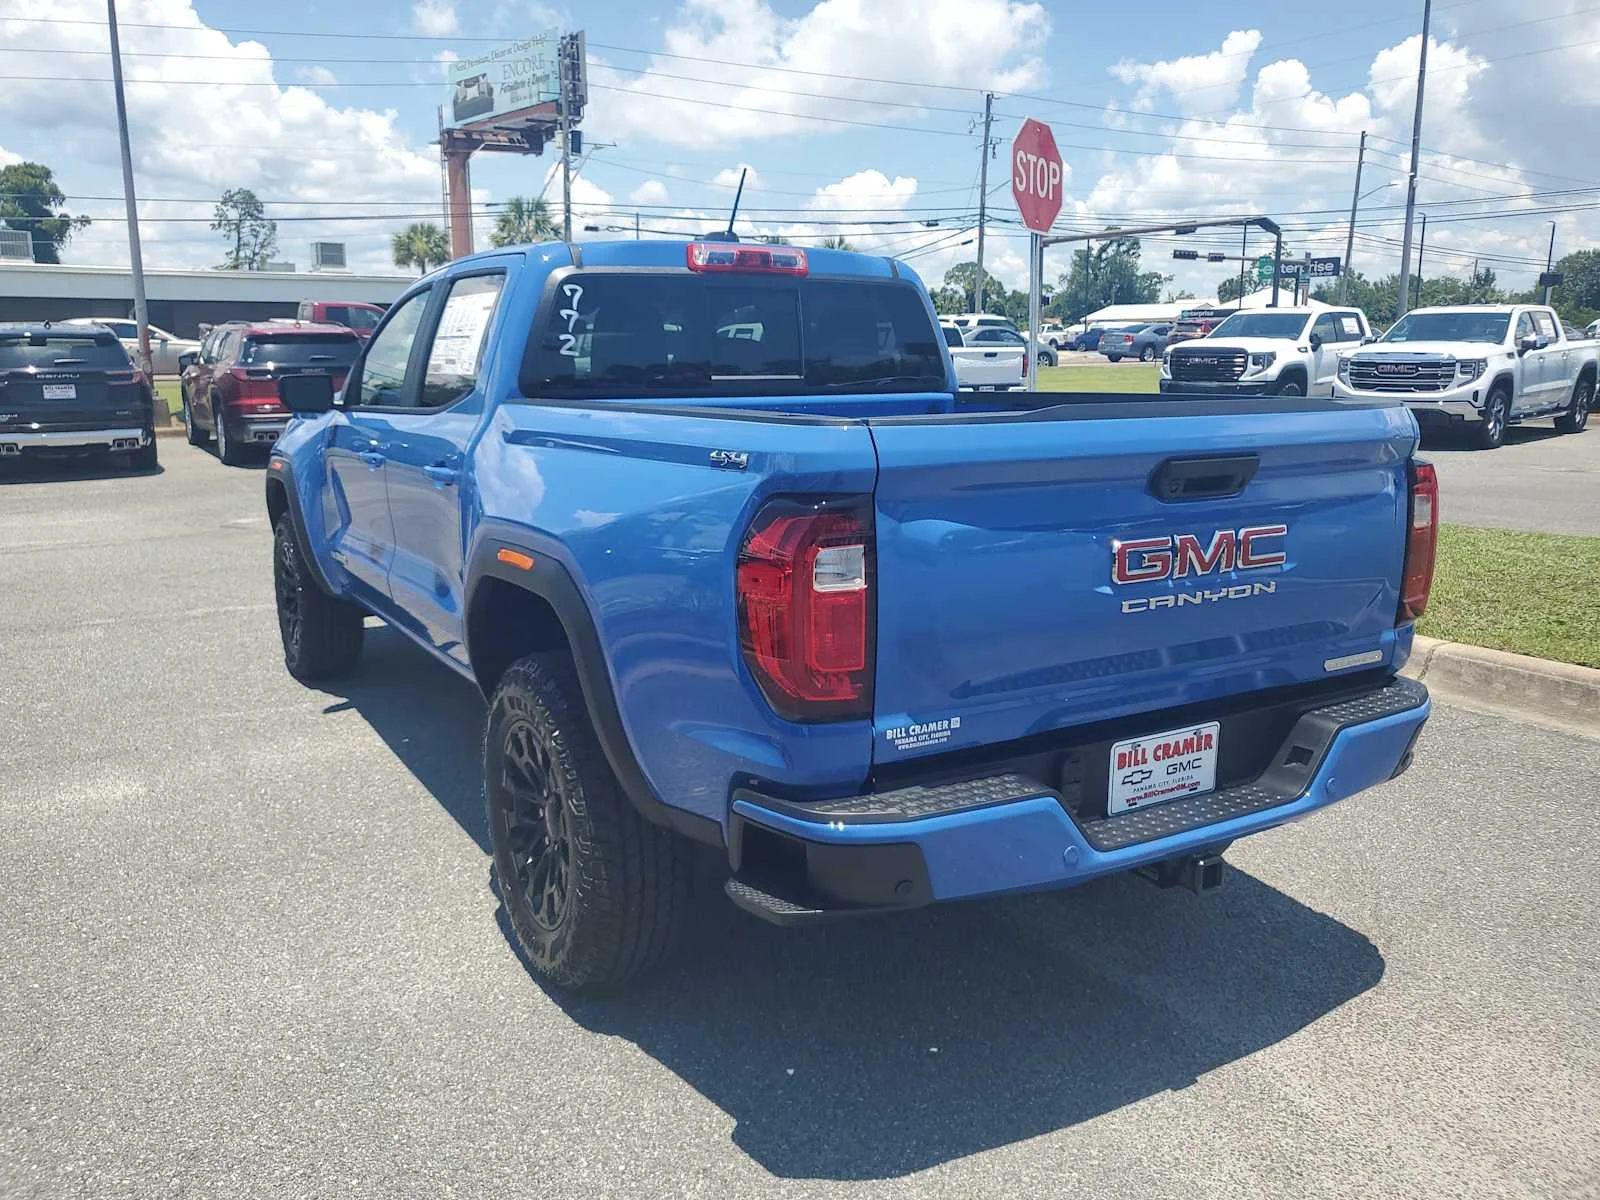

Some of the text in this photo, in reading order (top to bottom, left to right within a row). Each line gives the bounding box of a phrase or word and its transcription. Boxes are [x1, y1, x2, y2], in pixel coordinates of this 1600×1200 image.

[503, 52, 544, 80] ENCORE
[1015, 150, 1060, 200] STOP
[1377, 364, 1416, 374] GMC
[1112, 525, 1288, 585] GMC
[1121, 580, 1277, 614] CANYON
[886, 719, 949, 740] BILL CRAMER
[1117, 733, 1213, 770] BILL CRAMER
[1166, 757, 1202, 775] GMC
[1133, 784, 1157, 793] PANAMA
[1172, 774, 1194, 784] FLORIDA
